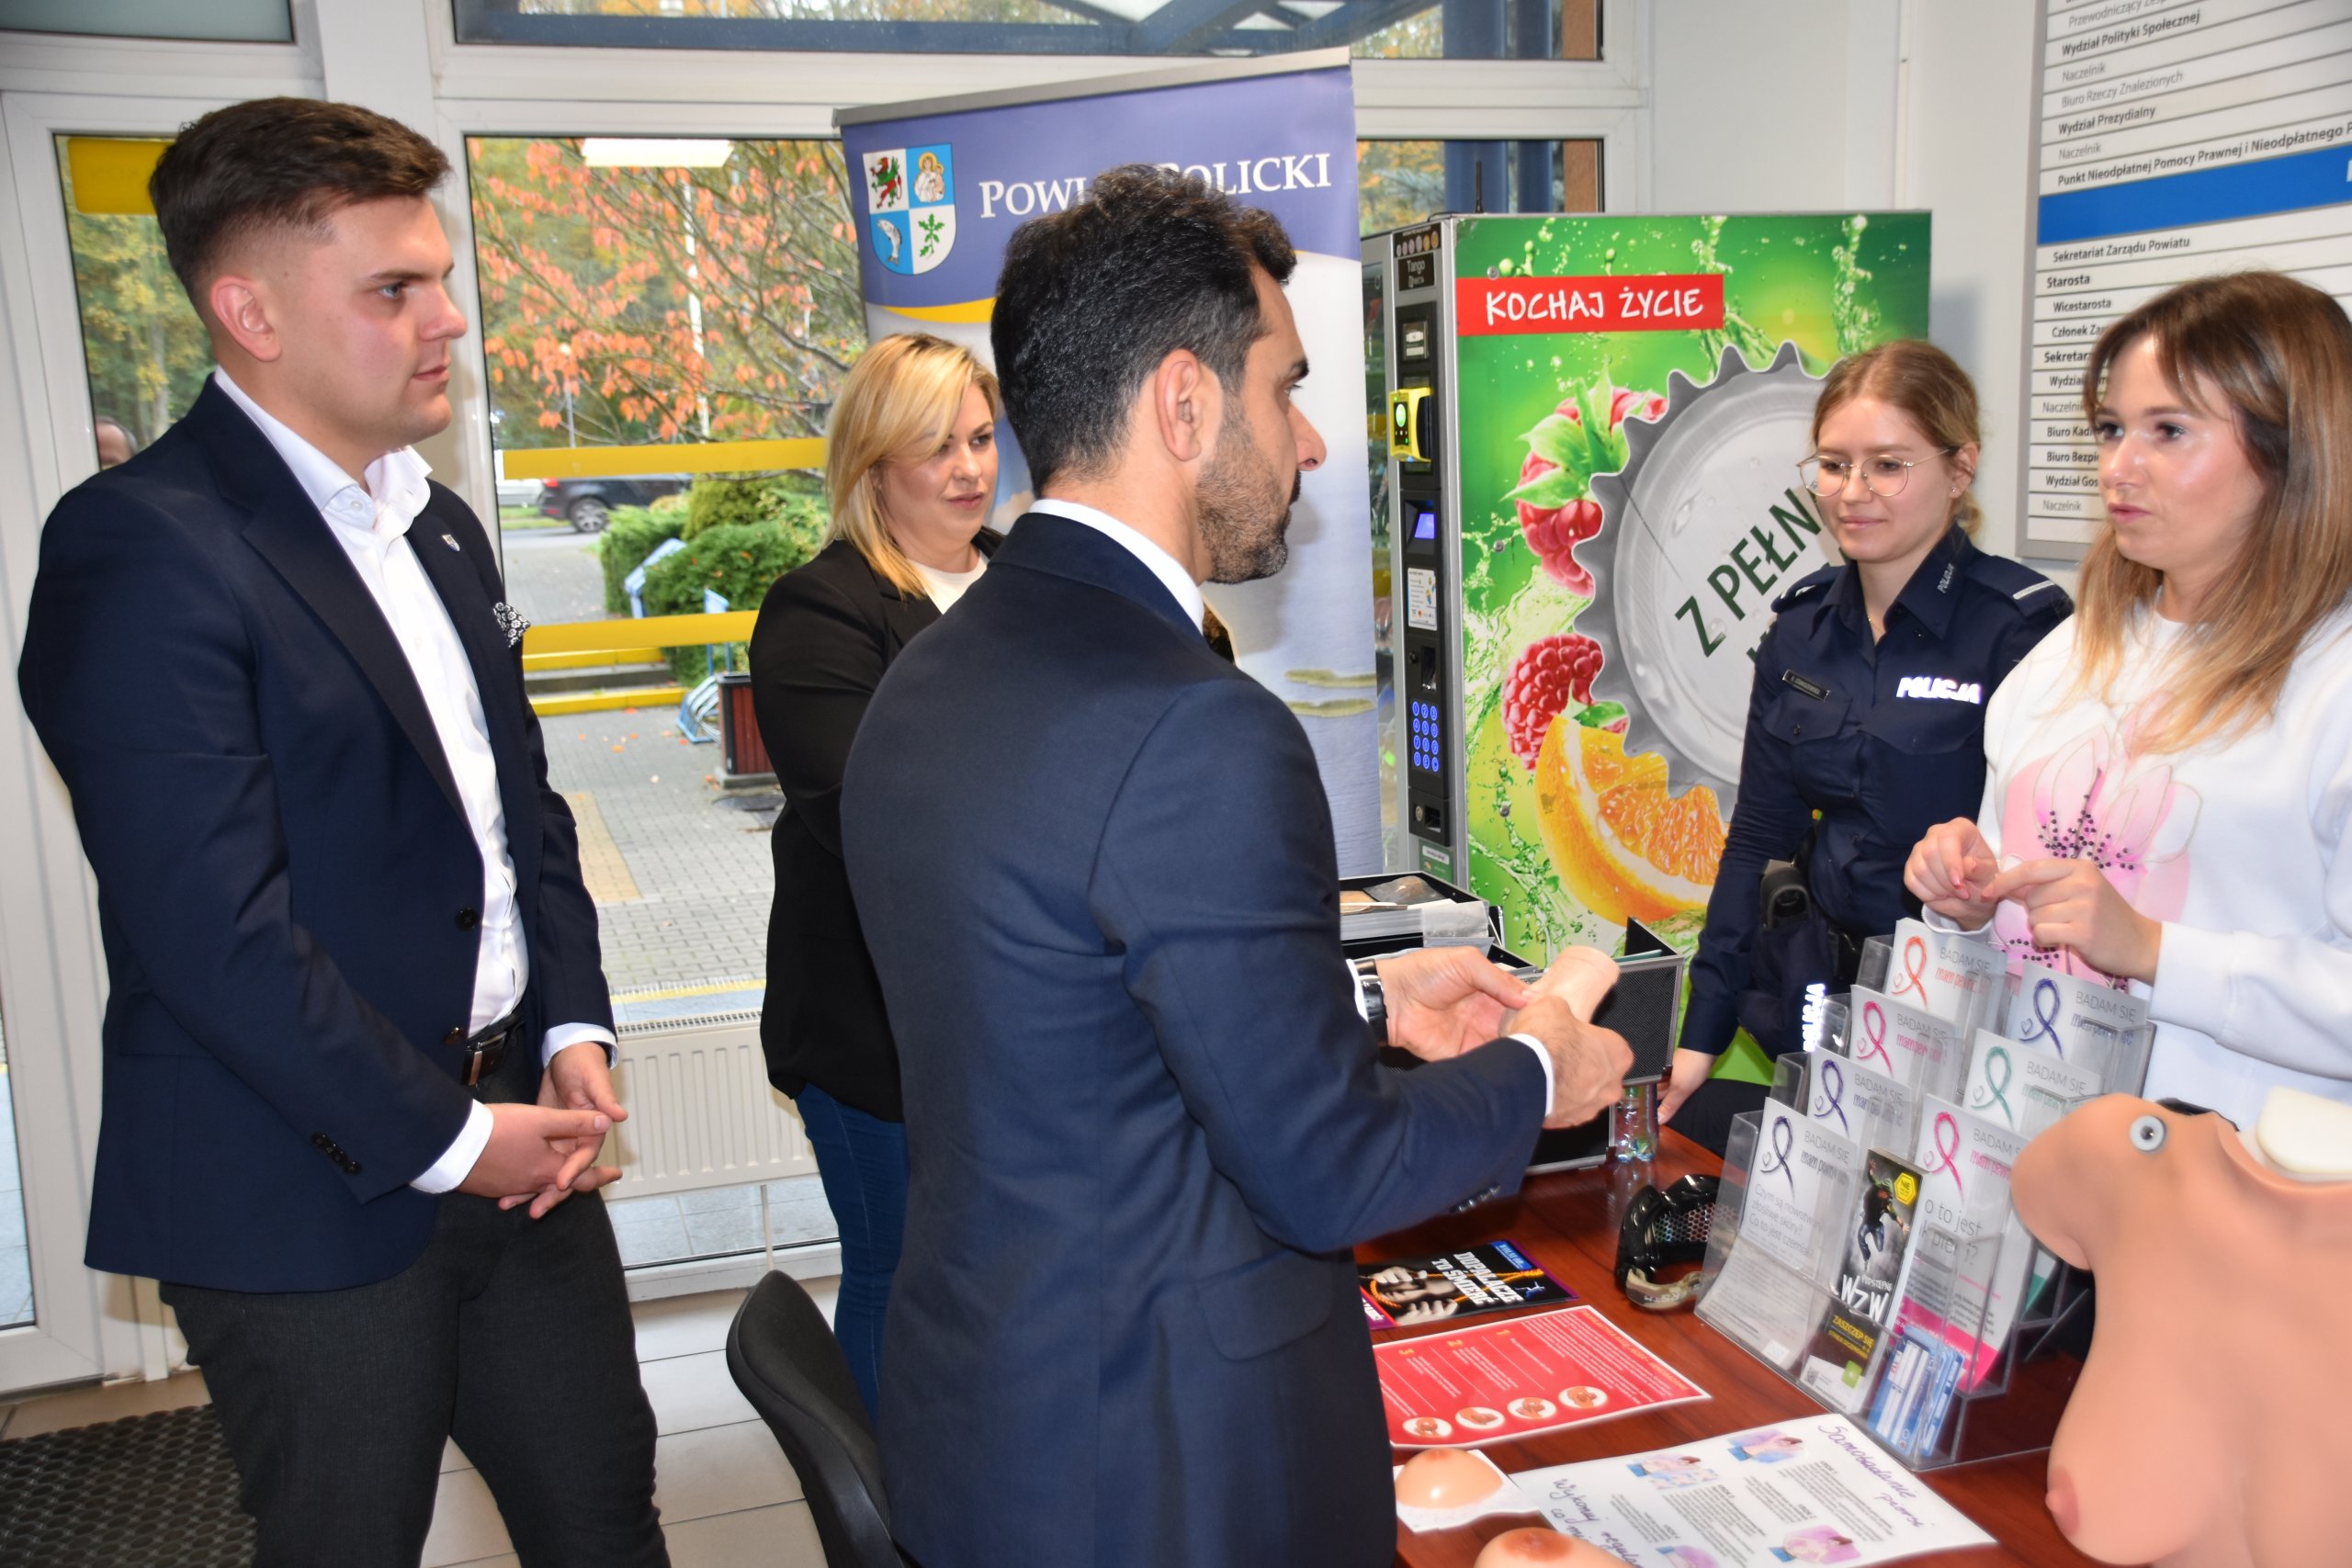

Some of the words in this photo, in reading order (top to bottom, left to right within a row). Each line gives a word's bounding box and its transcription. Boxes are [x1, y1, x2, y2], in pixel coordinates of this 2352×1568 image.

[2062, 37, 2099, 57] Wydział
[2102, 27, 2140, 45] Polityki
[2143, 10, 2200, 37] Społecznej
[2062, 62, 2106, 83] Naczelnik
[2062, 95, 2085, 108] Biuro
[2086, 87, 2117, 101] Rzeczy
[2120, 70, 2183, 96] Znalezionych
[2059, 118, 2095, 135] Wydział
[2098, 106, 2155, 126] Prezydialny
[2058, 170, 2086, 186] Punkt
[2087, 160, 2152, 183] Nieodpłatnej
[2154, 154, 2195, 170] Pomocy
[2199, 145, 2243, 162] Prawnej
[2251, 127, 2343, 153] Nieodpłatnego
[2059, 142, 2101, 161] Naczelnik
[2053, 247, 2104, 264] Sekretariat
[2107, 243, 2146, 258] Zarządu
[2149, 237, 2190, 252] Powiatu
[2047, 274, 2090, 288] Starosta
[1486, 289, 1604, 326] KOCHAJ
[1619, 286, 1703, 320] ŻYCIE
[2053, 298, 2111, 313] Wicestarosta
[2052, 325, 2087, 338] Członek
[2050, 376, 2085, 389] Wydzia
[2047, 426, 2071, 437] Biuro
[2047, 452, 2070, 462] Biuro
[2046, 475, 2080, 488] Wydział
[2042, 500, 2081, 511] Naczelnik
[1674, 595, 1726, 658] Z
[1707, 488, 1822, 622] PEŁN
[1895, 676, 1983, 705] POLICJA
[1939, 947, 1974, 968] BADAM
[2075, 991, 2117, 1014] BADAM
[1897, 1013, 1931, 1032] BADAM
[1855, 1073, 1888, 1097] BADAM
[2027, 1060, 2067, 1088] BADAM
[1804, 1130, 1837, 1156] BADAM
[1973, 1128, 2012, 1156] BADAM
[1938, 1201, 1952, 1224] to
[1954, 1210, 1983, 1236] jest
[1431, 1258, 1454, 1271] TO
[1442, 1269, 1499, 1306] ŚMIERĆ
[1453, 1251, 1524, 1304] DOPALACZE
[1818, 1425, 1917, 1498] Samobadanie
